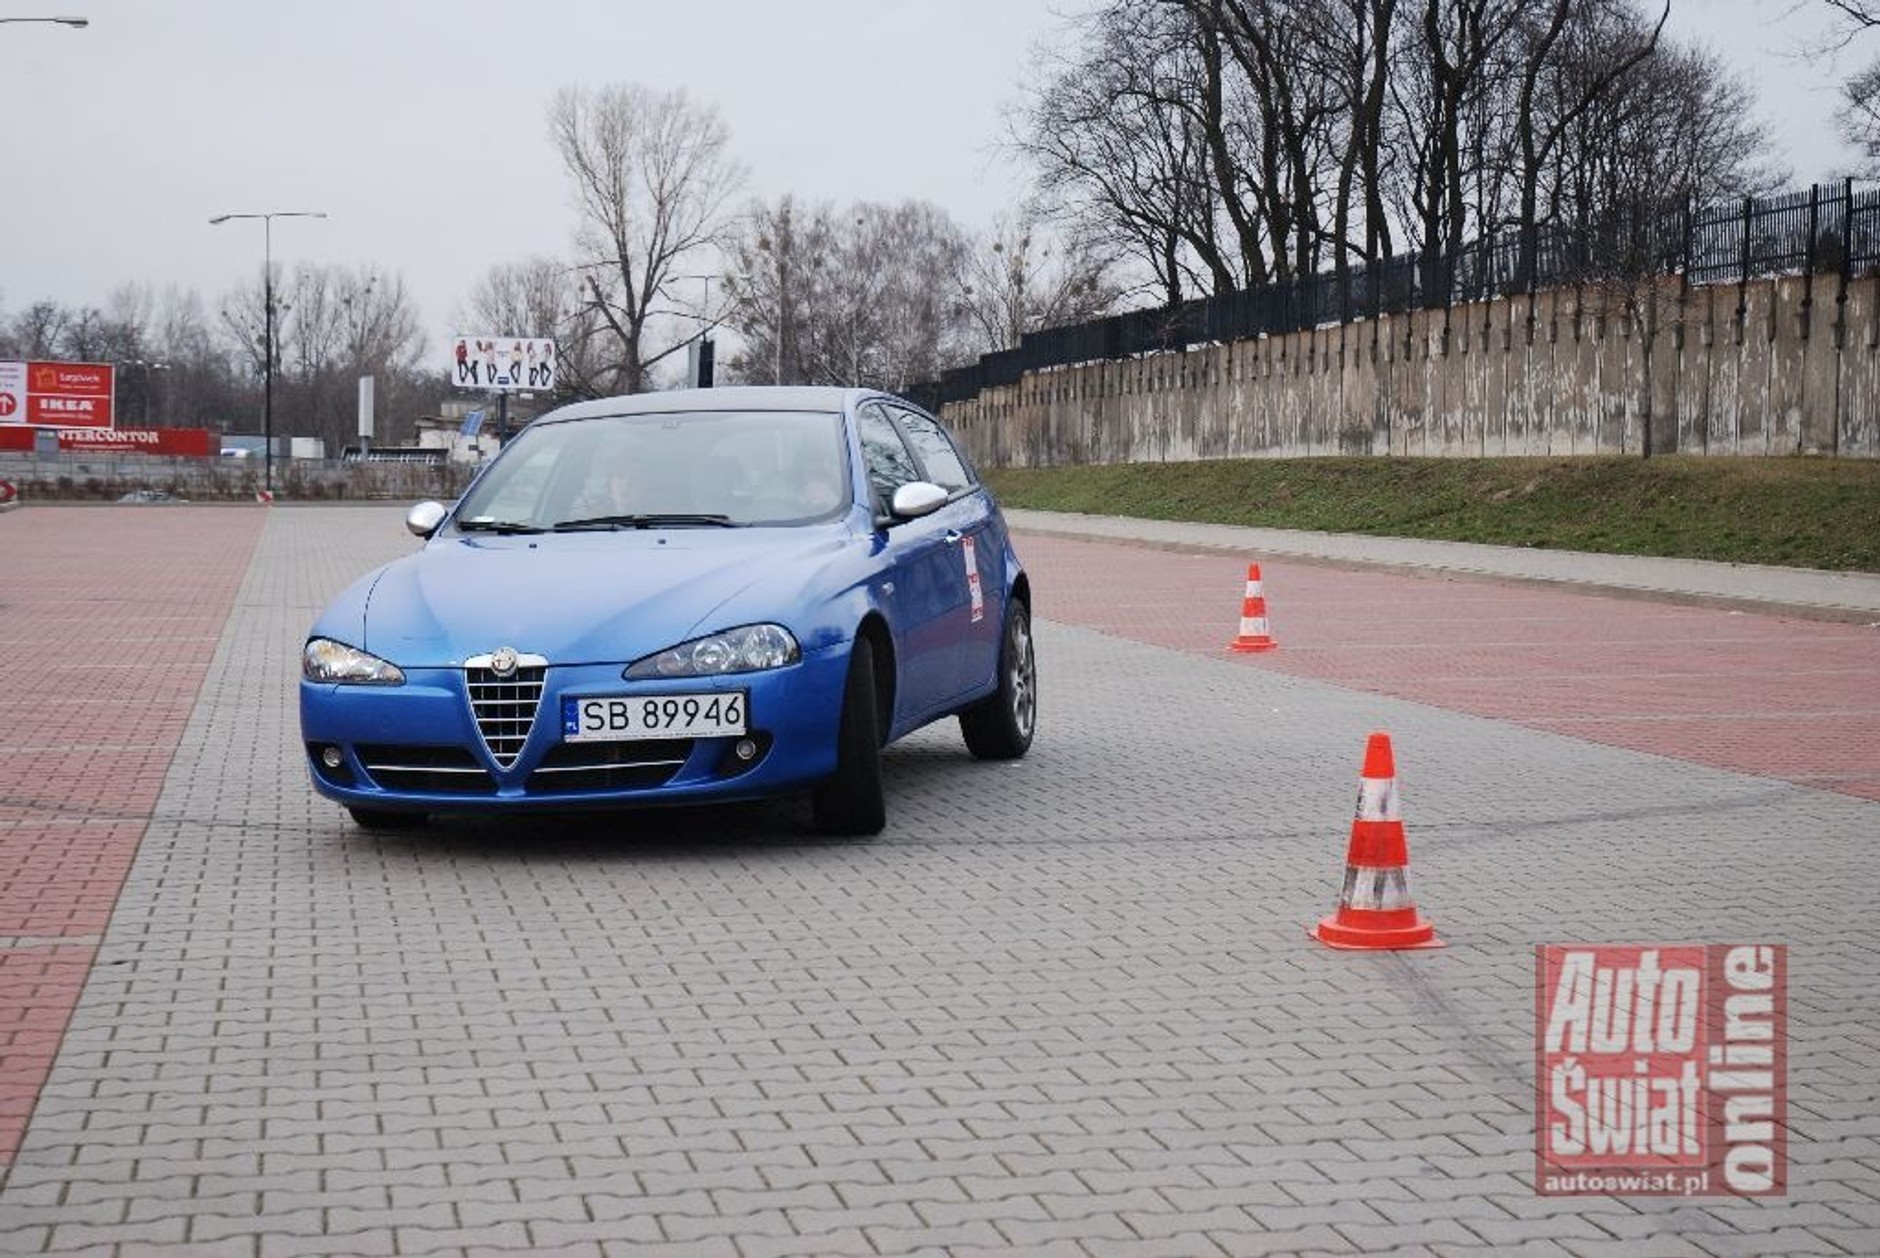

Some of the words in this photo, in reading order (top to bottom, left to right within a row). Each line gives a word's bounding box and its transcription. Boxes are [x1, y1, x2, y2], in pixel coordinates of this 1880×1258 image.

[40, 398, 93, 411] IKEA
[583, 701, 630, 731] SB
[642, 695, 741, 729] 89946
